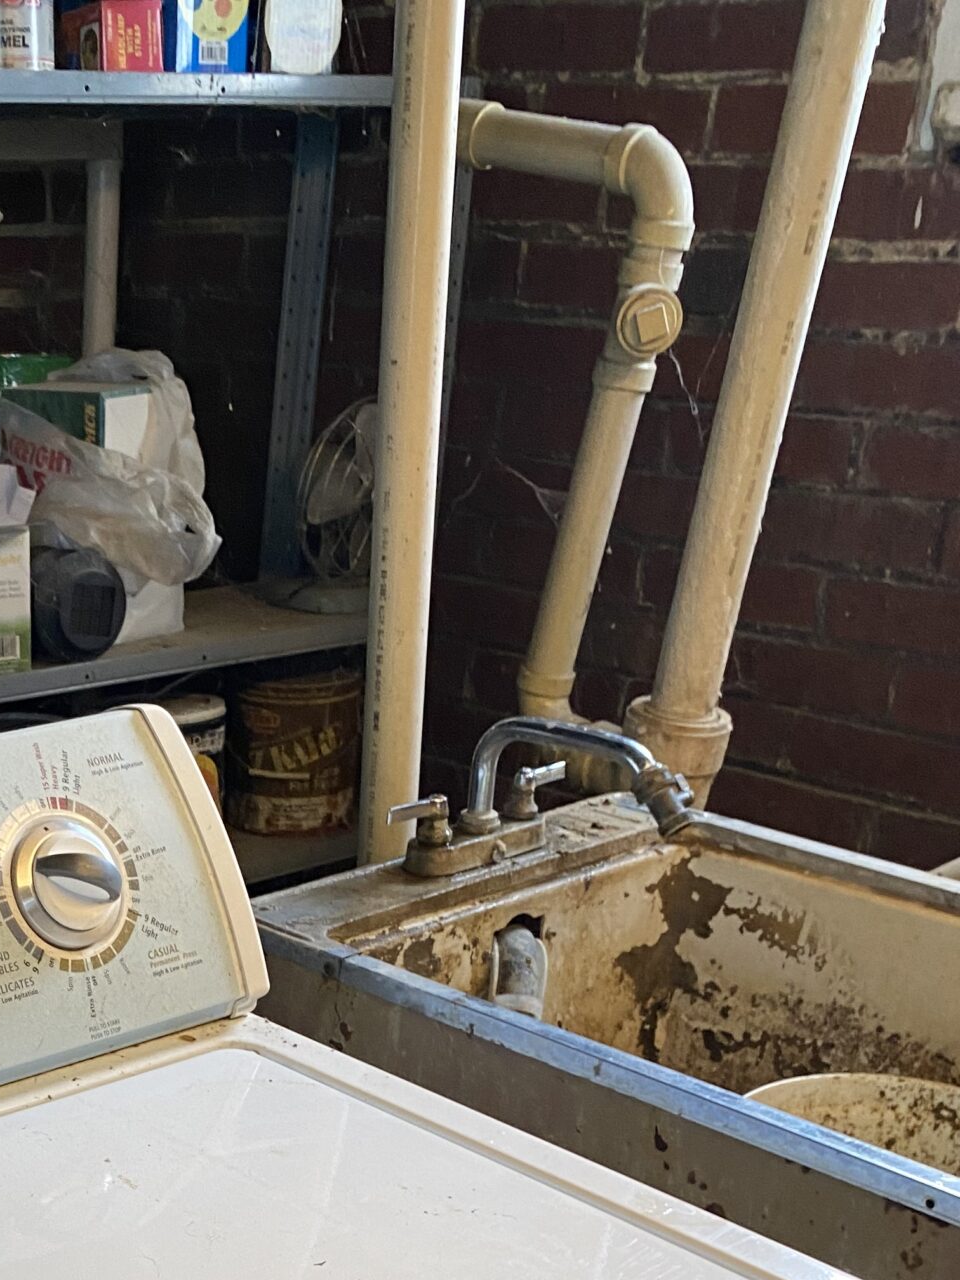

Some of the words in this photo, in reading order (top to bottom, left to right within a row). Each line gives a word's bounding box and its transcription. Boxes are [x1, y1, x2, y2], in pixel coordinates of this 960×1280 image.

[61, 750, 71, 784] Regular
[86, 752, 125, 768] NORMAL
[50, 765, 58, 790] Heavy
[73, 774, 81, 796] Light
[141, 925, 159, 941] Light
[150, 916, 179, 936] Regular
[147, 943, 179, 961] CASUAL
[1, 996, 14, 1005] Low
[14, 989, 39, 1001] Agitation
